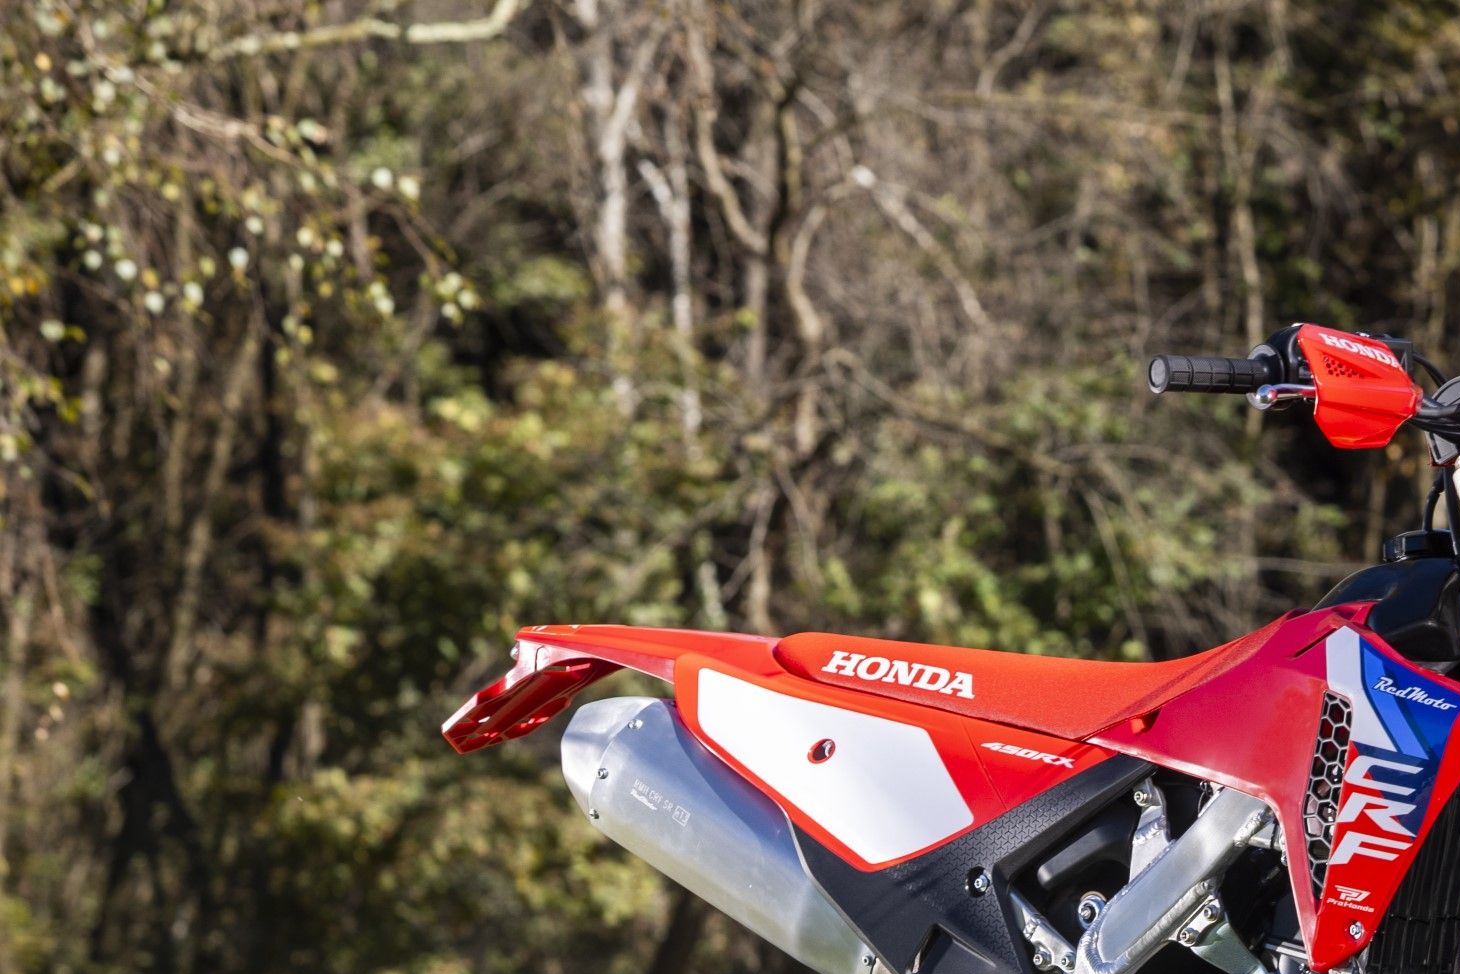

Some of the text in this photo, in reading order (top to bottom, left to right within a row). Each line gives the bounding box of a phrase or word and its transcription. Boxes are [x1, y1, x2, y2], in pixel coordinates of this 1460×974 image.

[821, 650, 975, 699] HONDA
[1373, 676, 1458, 711] RedMoto
[980, 742, 1074, 769] 450RX
[1328, 755, 1424, 866] CRF
[1326, 897, 1375, 913] ProHonda
